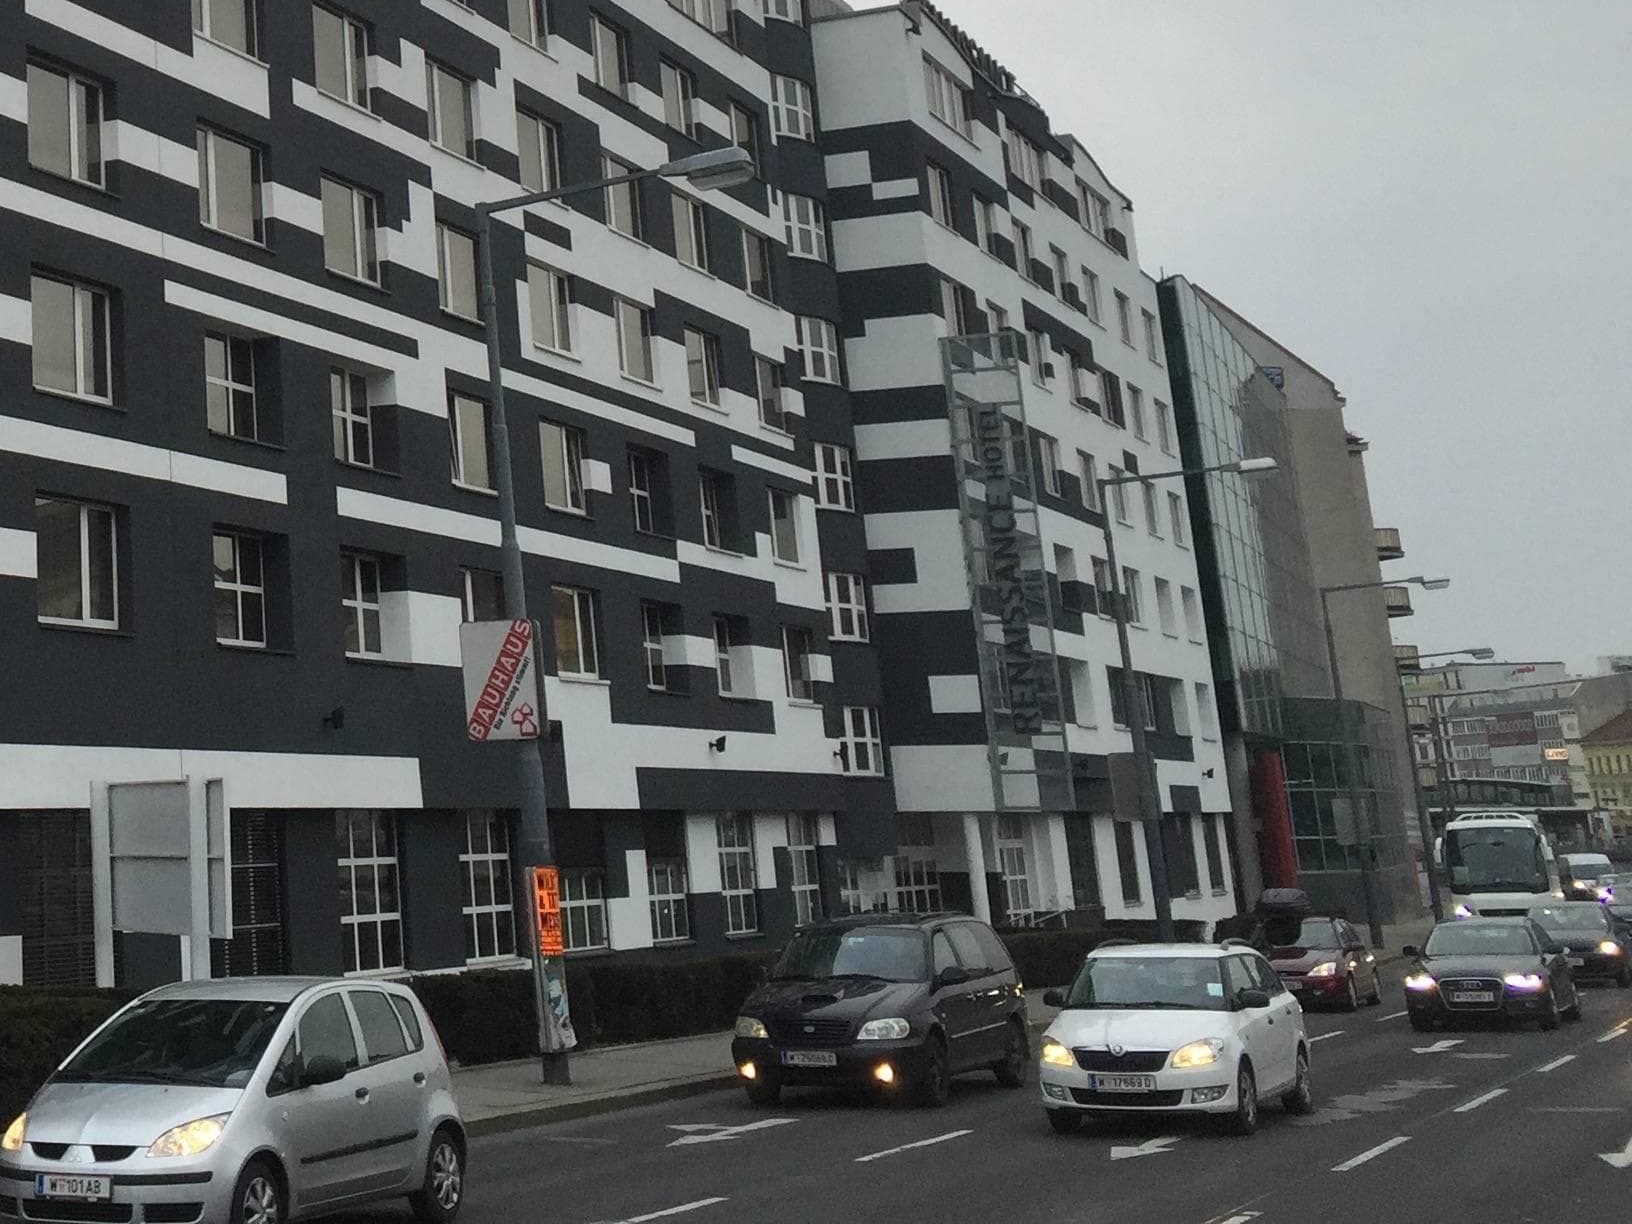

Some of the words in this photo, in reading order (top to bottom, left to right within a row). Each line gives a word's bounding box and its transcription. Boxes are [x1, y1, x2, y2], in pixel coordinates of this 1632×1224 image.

[979, 404, 1005, 479] HOTEL
[987, 490, 1043, 734] RENAISSANCE
[469, 619, 531, 740] BAUHAUS
